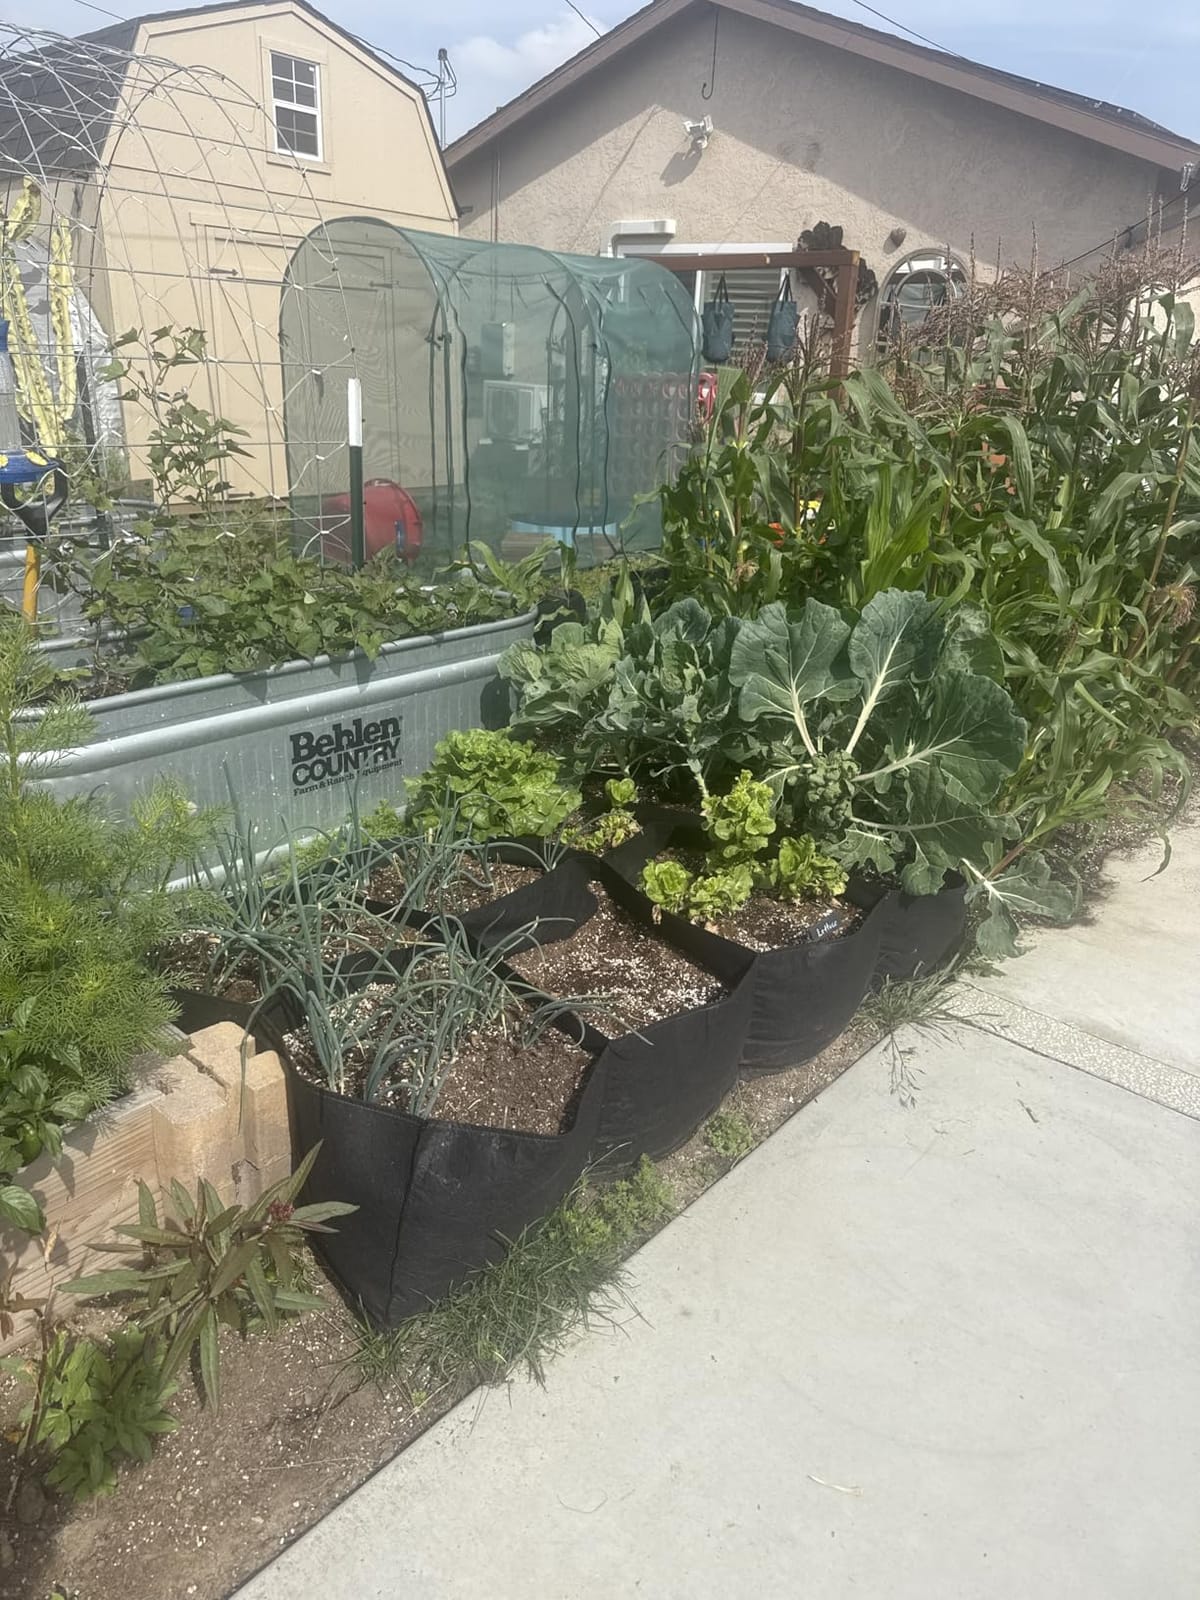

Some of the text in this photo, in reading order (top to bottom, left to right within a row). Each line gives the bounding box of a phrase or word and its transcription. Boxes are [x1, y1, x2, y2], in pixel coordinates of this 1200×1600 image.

[289, 717, 401, 765] Behlen
[292, 737, 401, 786] COUNTRY
[293, 784, 319, 796] Farm
[326, 772, 355, 786] Ranch
